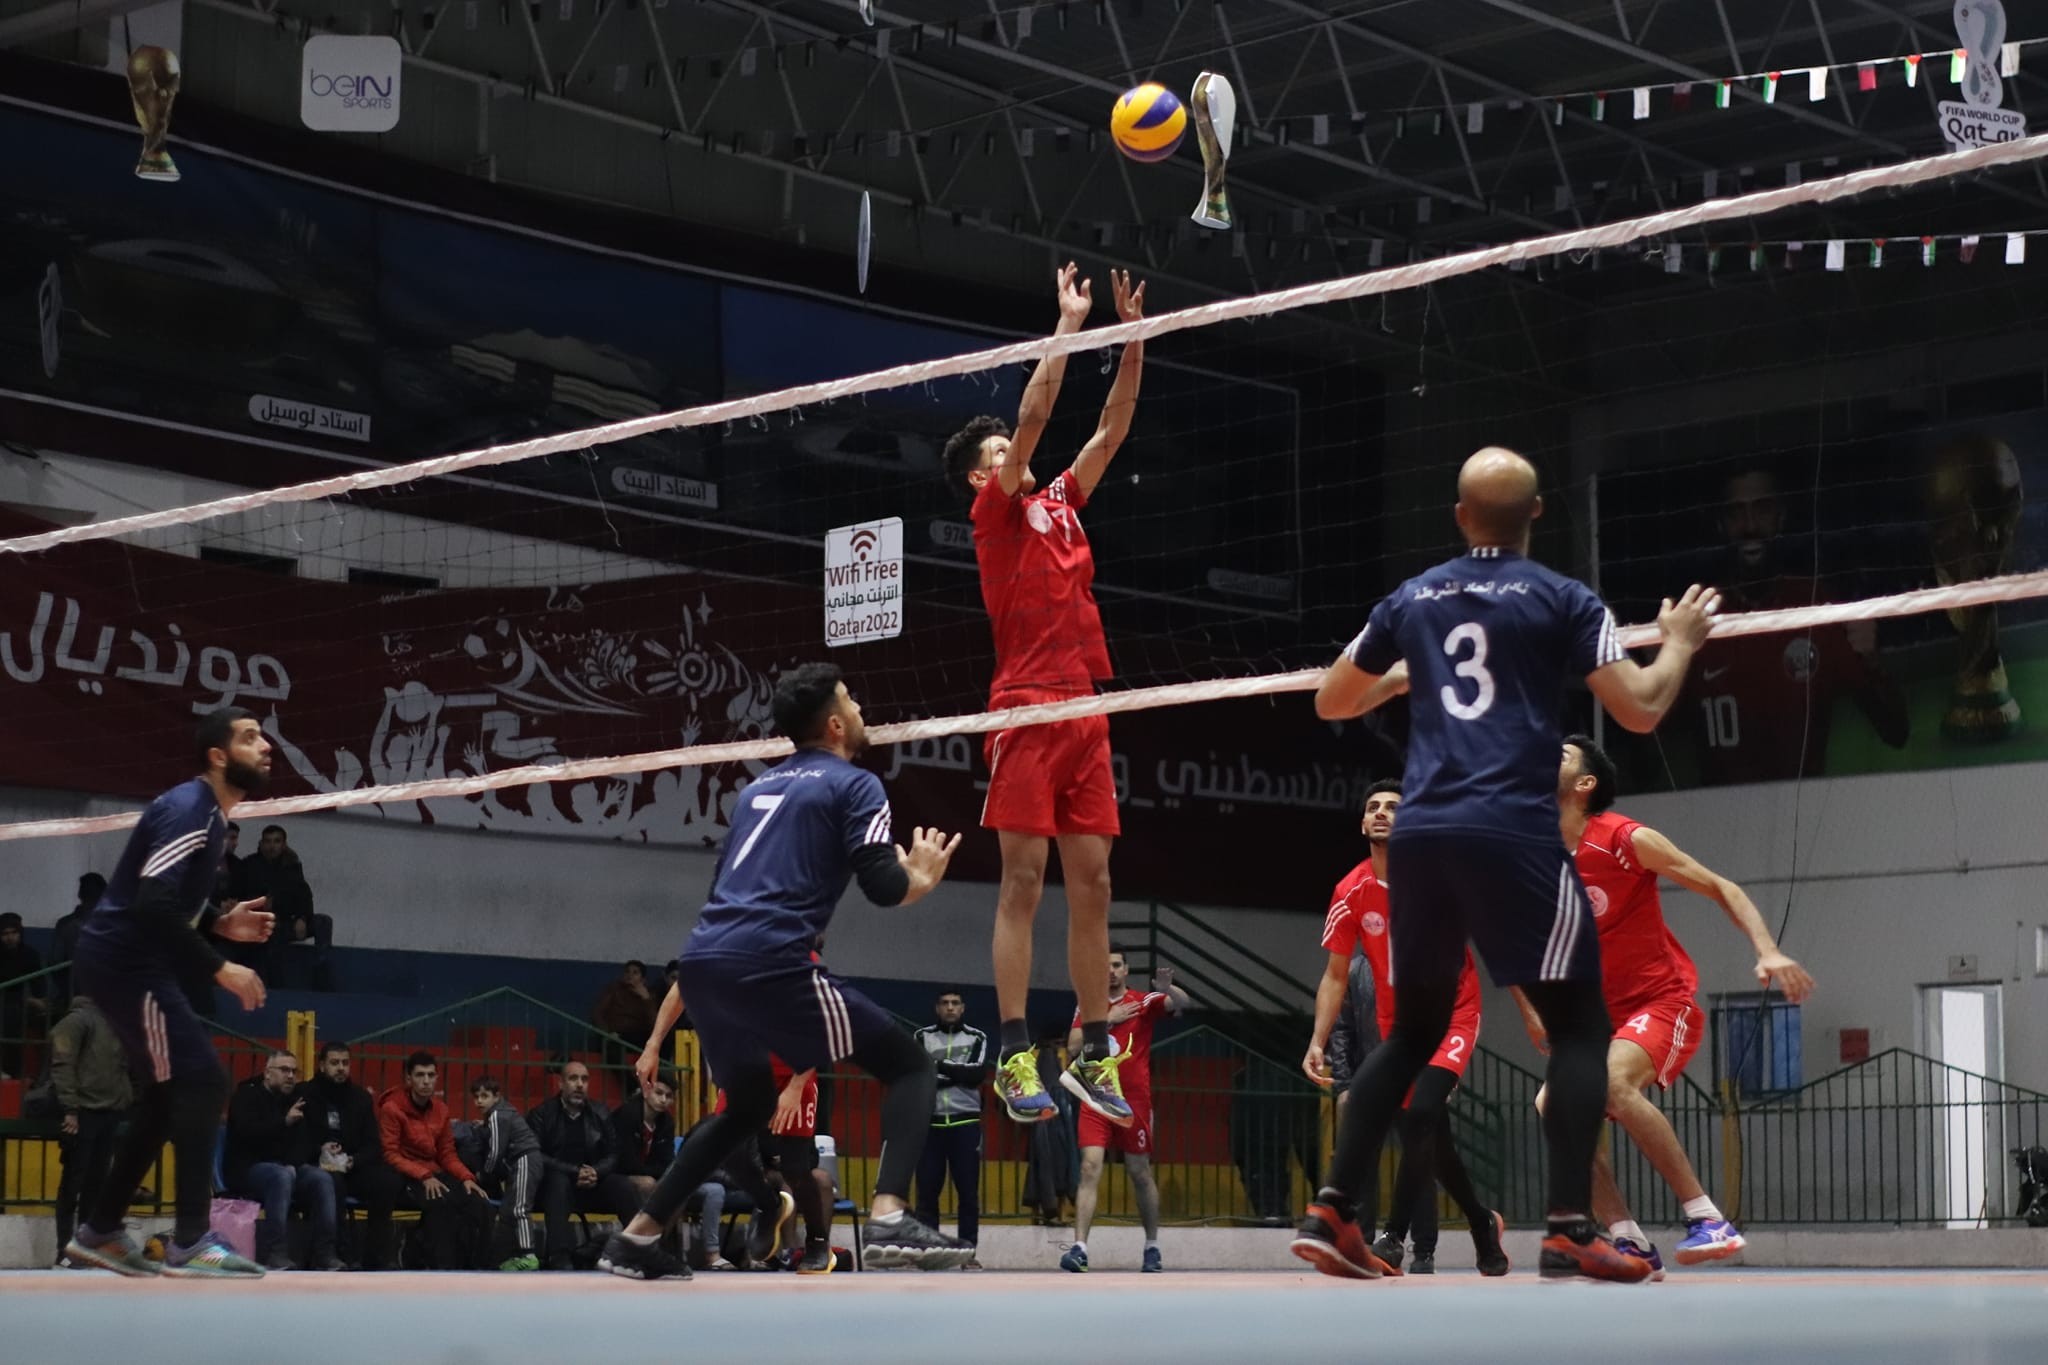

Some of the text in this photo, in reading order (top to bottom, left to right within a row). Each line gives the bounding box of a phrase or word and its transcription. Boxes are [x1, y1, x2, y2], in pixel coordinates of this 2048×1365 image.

[311, 68, 391, 97] beIN
[343, 98, 392, 109] SPORTS
[1946, 106, 2020, 126] FIFA WORLD CUP
[261, 399, 363, 434] استاد لوسيل
[665, 478, 706, 500] استاد
[829, 560, 899, 587] Wifi Free
[827, 583, 898, 613] انترنت مجاني
[828, 611, 898, 638] Qatar2022
[0, 591, 291, 715] مونديال
[1441, 622, 1496, 720] 3
[1701, 694, 1740, 747] 10
[732, 794, 786, 871] 7
[1626, 1013, 1650, 1035] 4
[1447, 1035, 1465, 1064] 2
[1137, 1128, 1147, 1148] 3
